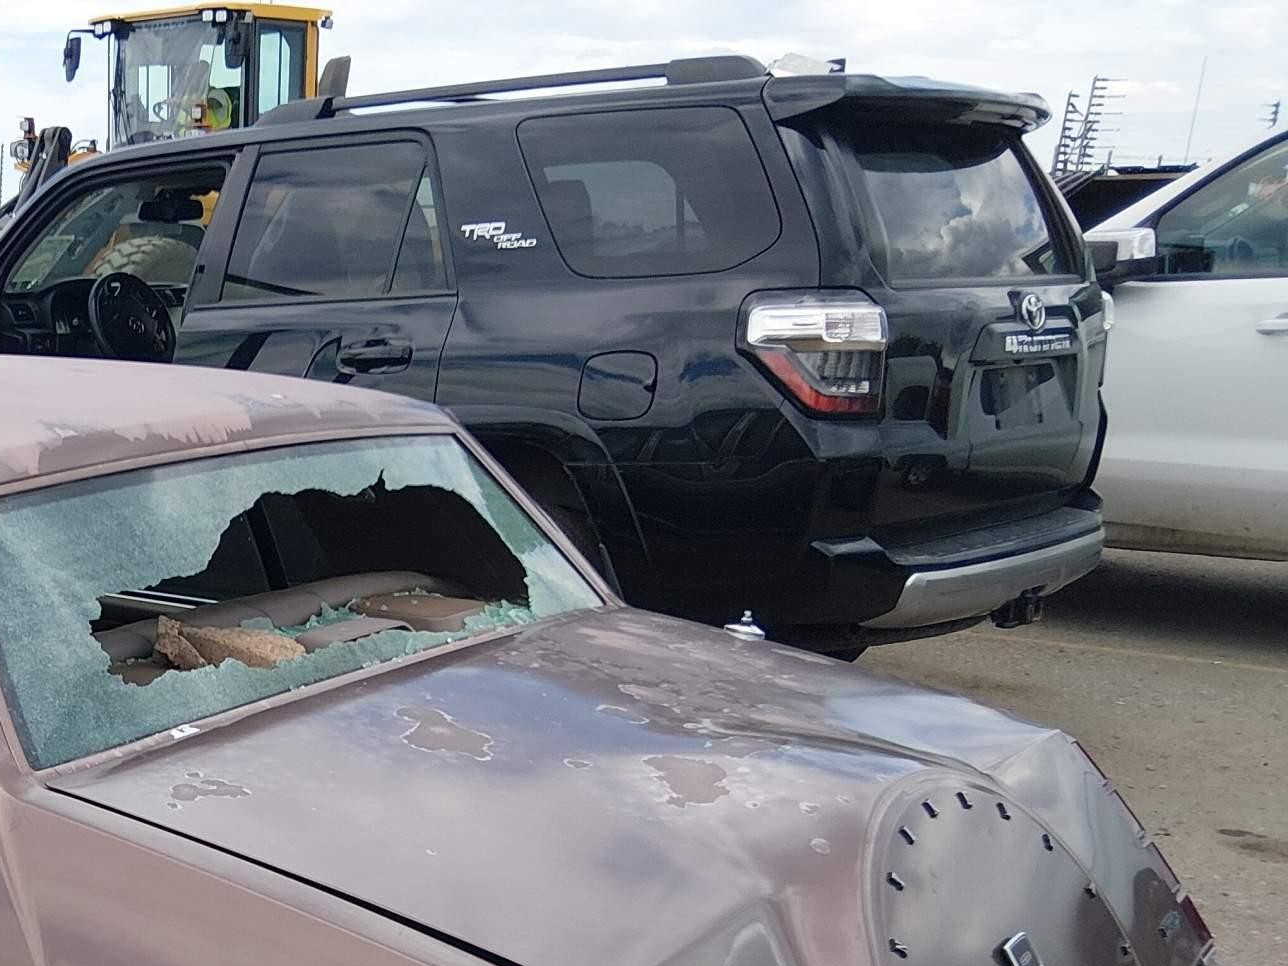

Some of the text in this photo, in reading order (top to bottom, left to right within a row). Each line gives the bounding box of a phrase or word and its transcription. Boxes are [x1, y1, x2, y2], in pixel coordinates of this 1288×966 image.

[460, 221, 506, 240] TRD
[493, 232, 522, 243] OFF
[497, 239, 537, 249] ROAD
